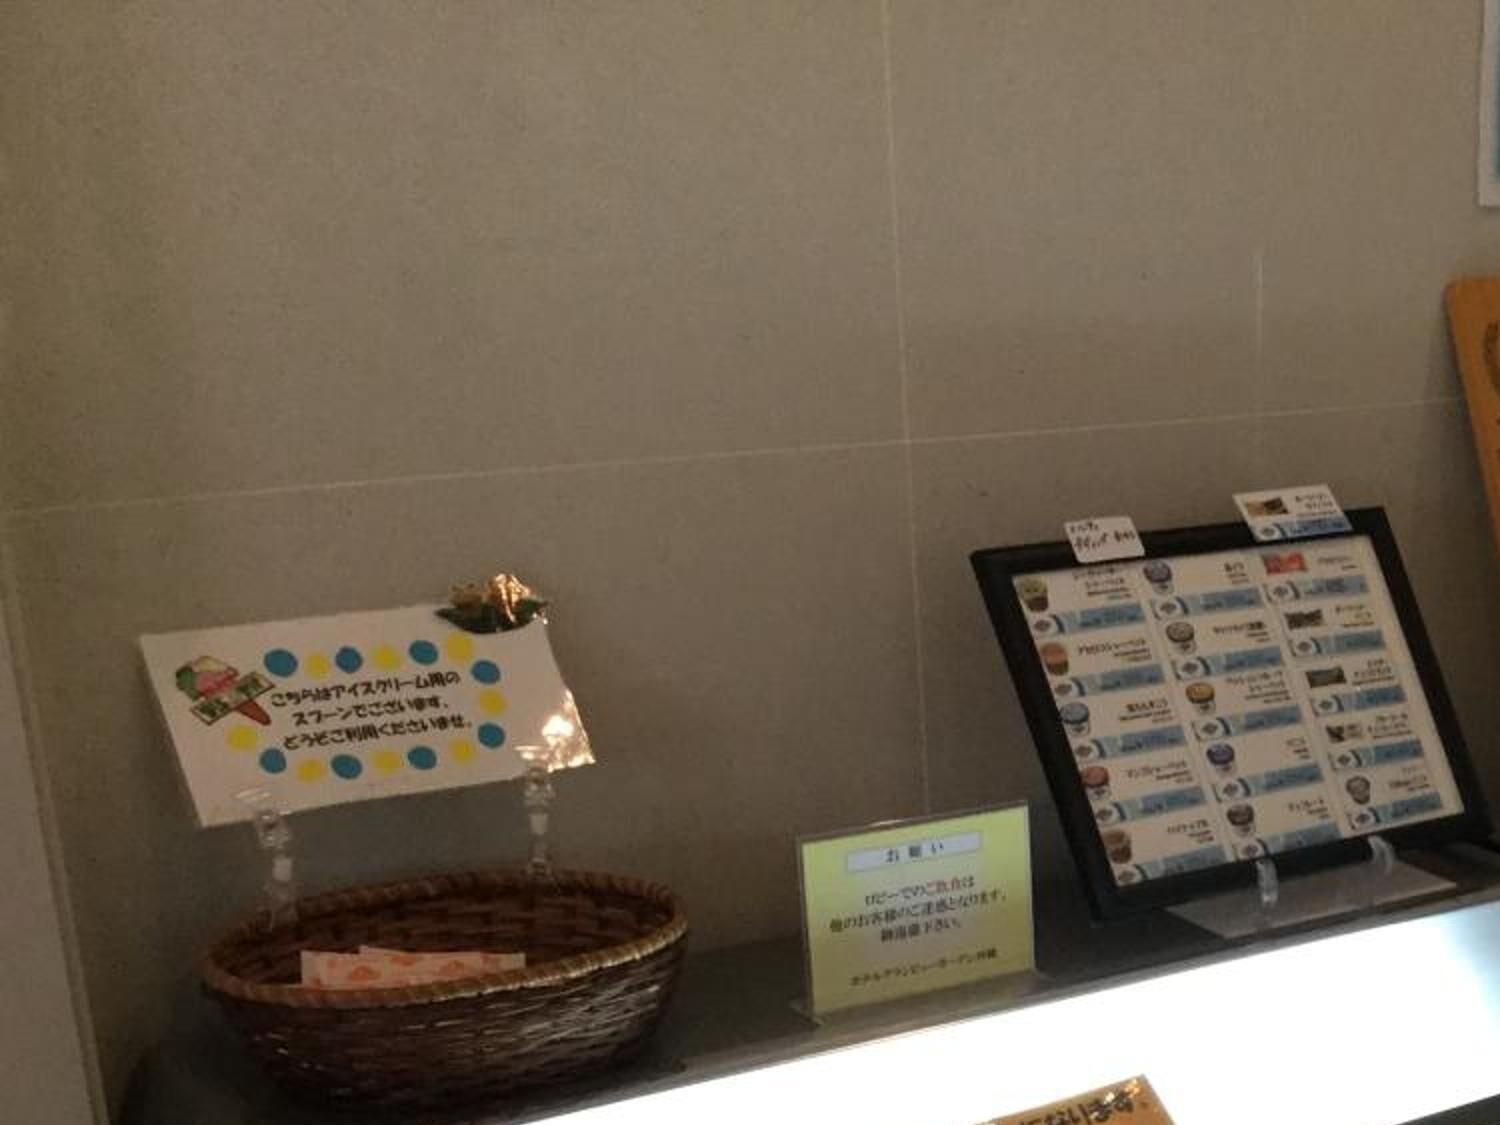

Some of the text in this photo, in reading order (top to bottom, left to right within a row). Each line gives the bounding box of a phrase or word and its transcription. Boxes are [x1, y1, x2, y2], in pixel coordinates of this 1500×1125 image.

[271, 671, 461, 707] こちらはアイスクリーム用の
